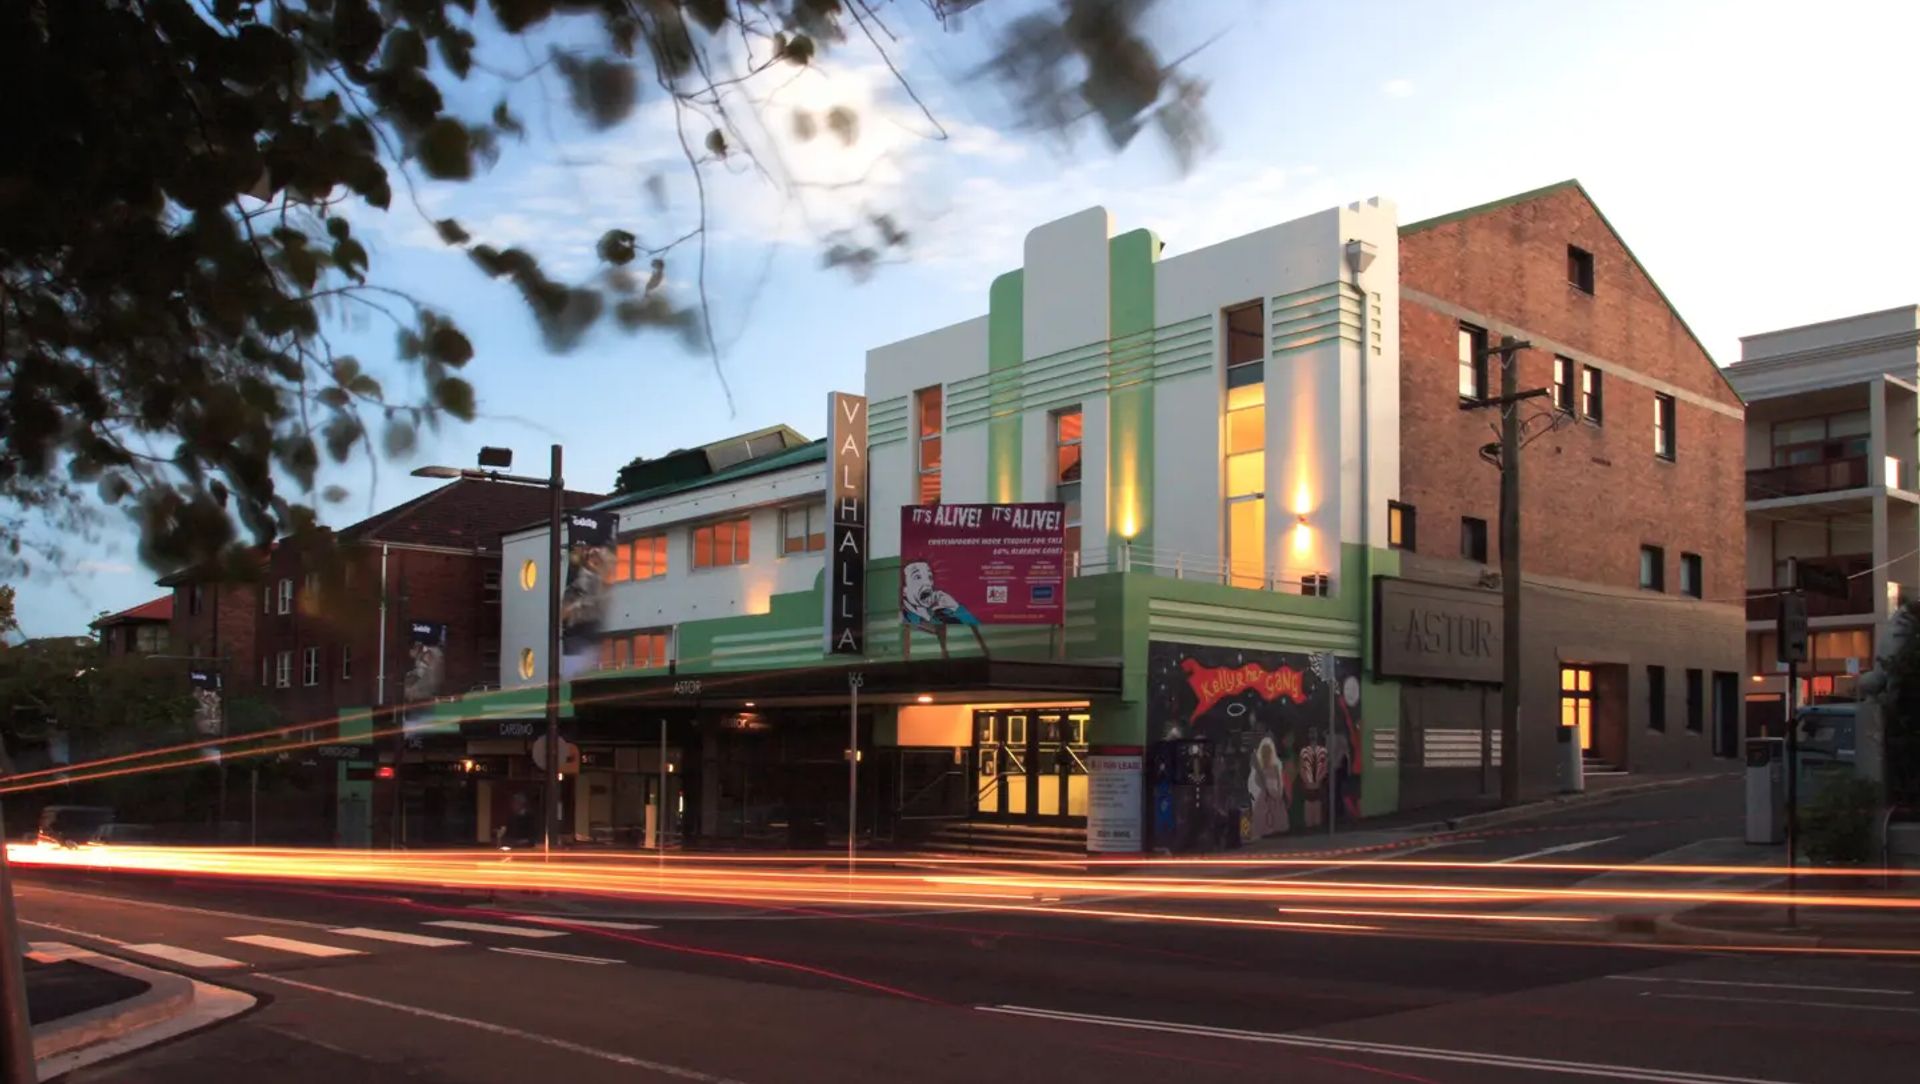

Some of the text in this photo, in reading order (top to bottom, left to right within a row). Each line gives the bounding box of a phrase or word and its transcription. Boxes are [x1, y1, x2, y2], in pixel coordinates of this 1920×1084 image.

[838, 400, 860, 650] VALHALLA
[912, 506, 1061, 531] IT'S ALIVE! IT'S ALIVE!
[1405, 608, 1491, 658] ASTOR
[672, 680, 702, 695] ASTOR
